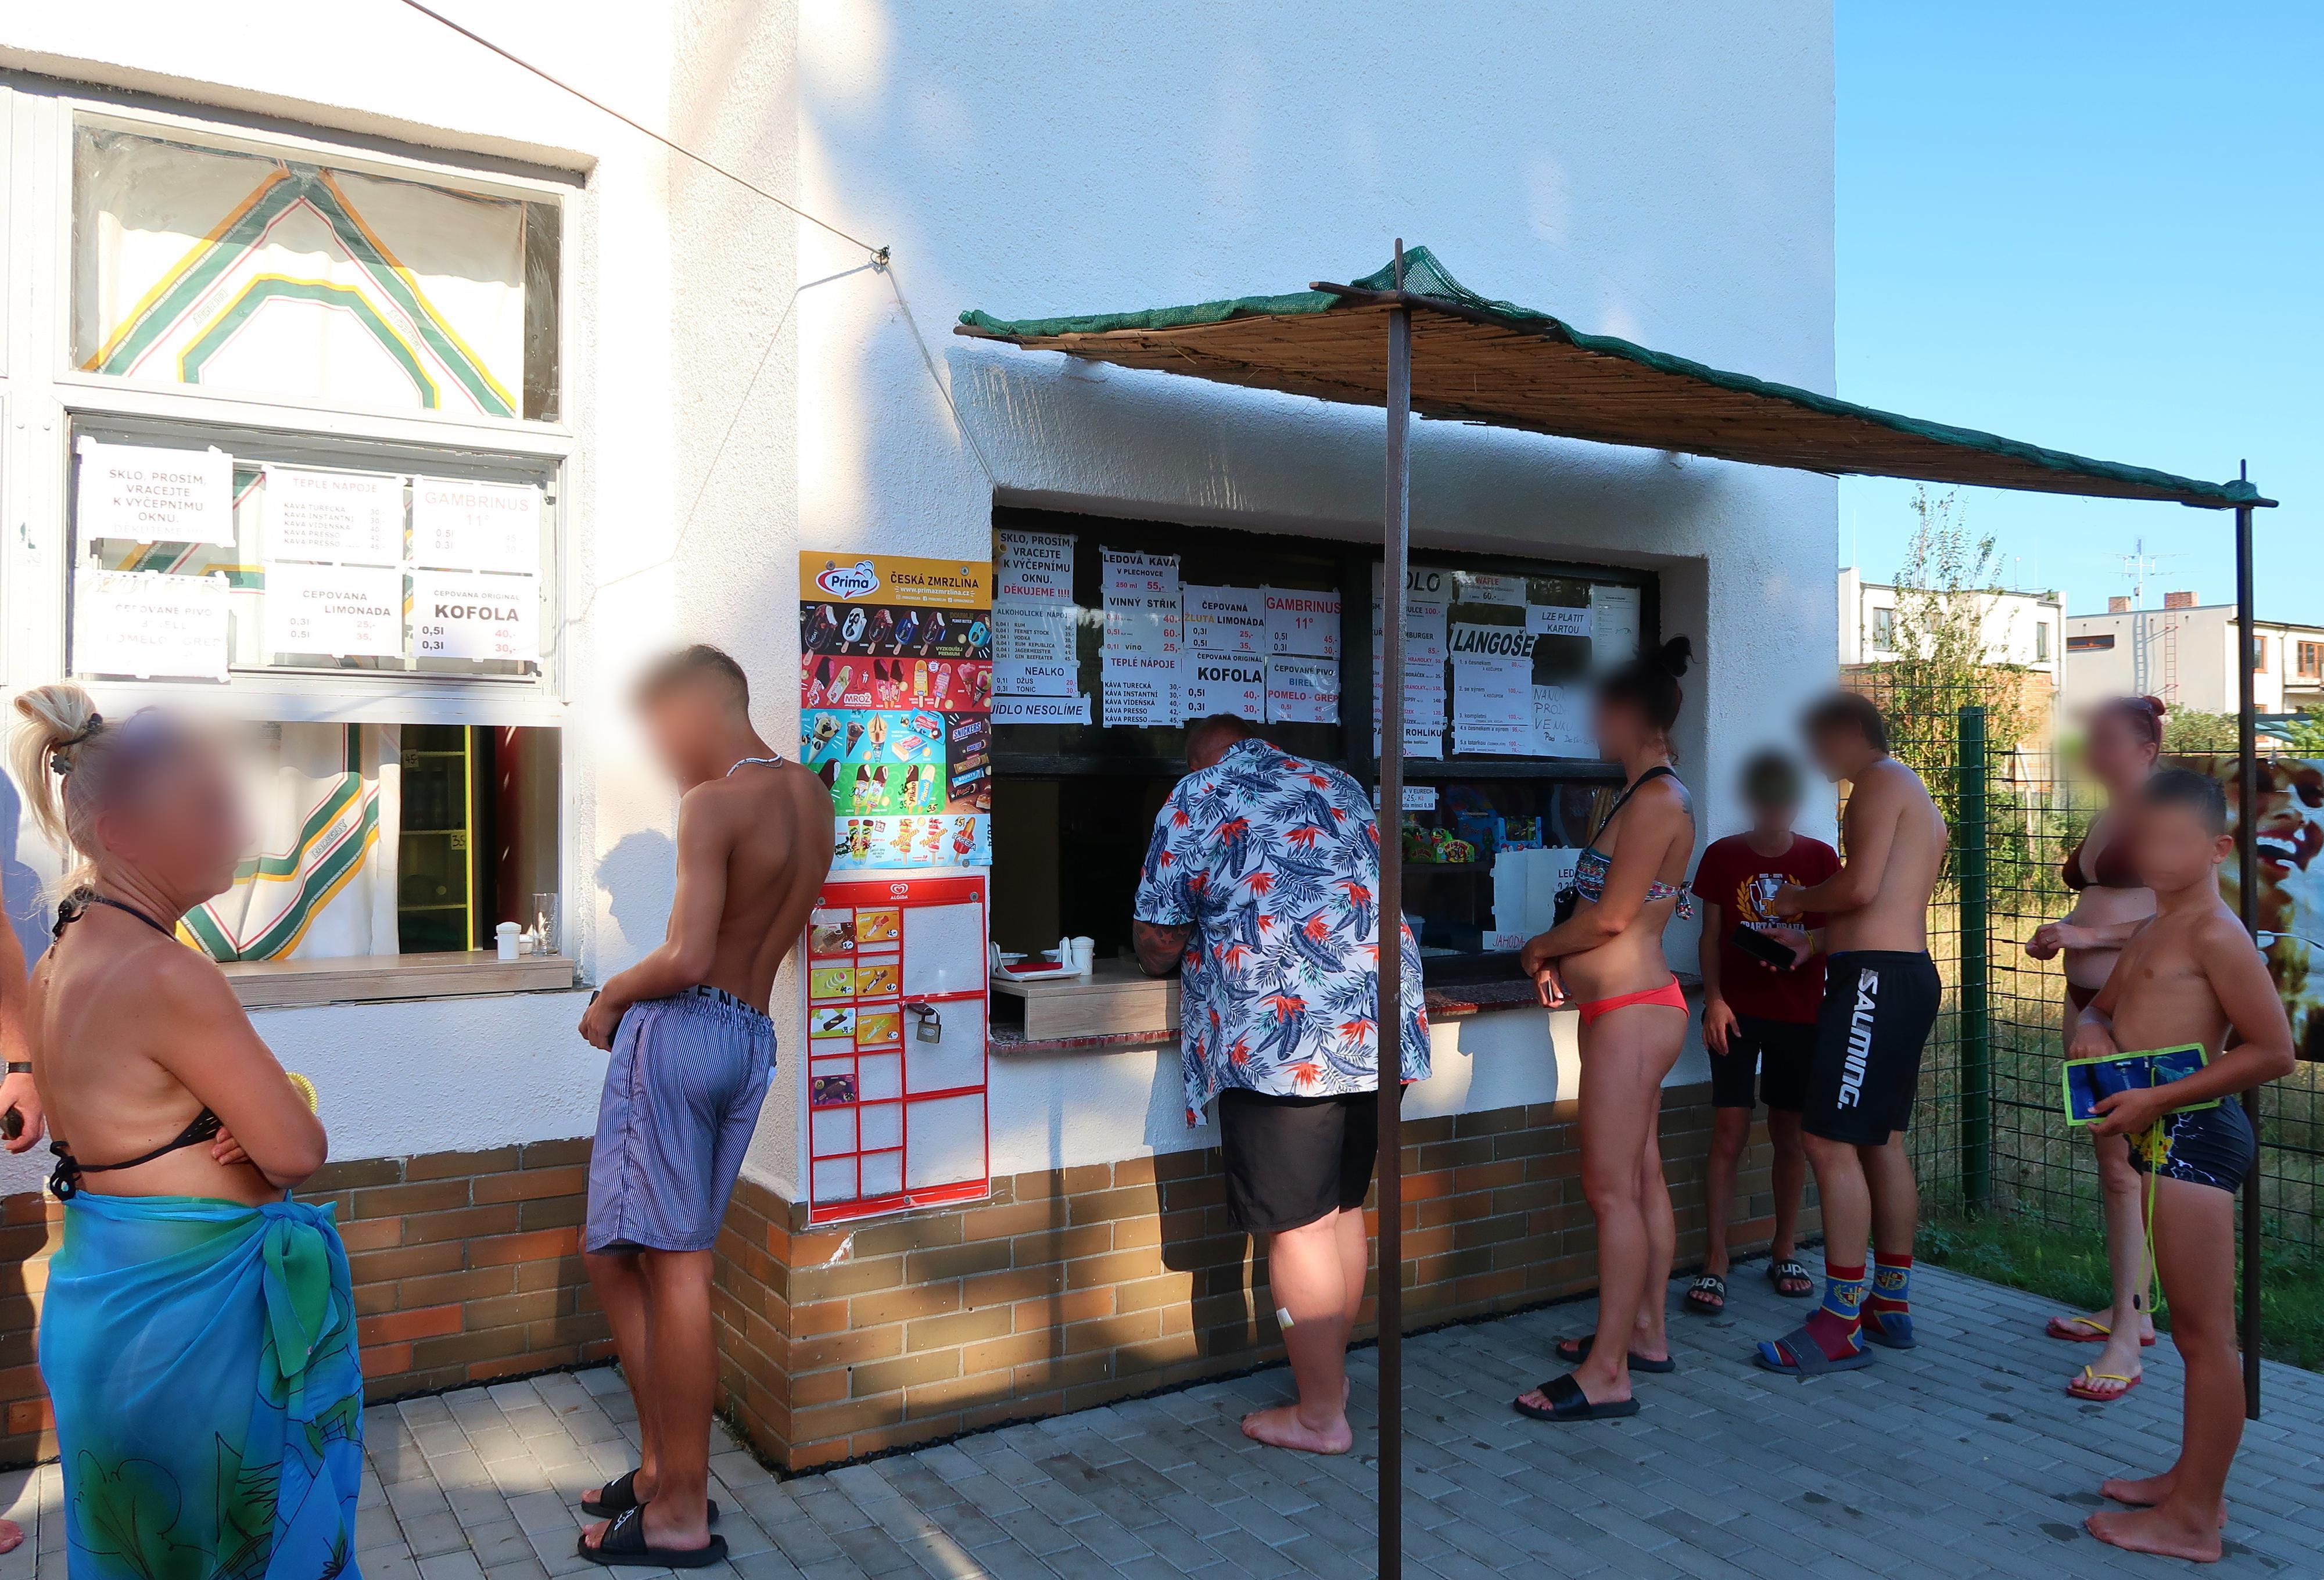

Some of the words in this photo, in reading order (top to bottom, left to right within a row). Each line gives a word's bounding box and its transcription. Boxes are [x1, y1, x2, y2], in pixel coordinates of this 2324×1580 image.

[127, 484, 190, 496] VRACEJTE
[114, 497, 121, 506] K
[425, 492, 528, 511] GAMBRINUS
[1000, 533, 1028, 545] SKLO,
[1032, 536, 1073, 549] PROSÍM,
[1013, 547, 1061, 558] VRACEJTE
[1004, 559, 1010, 568] K
[1013, 558, 1070, 572] VÝČEPNÍMU
[1104, 554, 1143, 565] LEDOVÁ
[1149, 558, 1176, 567] KÁVA
[831, 575, 869, 589] Prima
[891, 572, 924, 585] ČESKÁ
[928, 576, 979, 588] ZMRZLINA
[1022, 574, 1052, 584] OKNU.
[1476, 577, 1500, 586] WAFLE
[901, 587, 970, 596] www.primazmrzlina.cz
[1004, 583, 1055, 597] DĚKUJEME
[1058, 589, 1069, 598] !!!!
[1147, 581, 1164, 591] 55,-
[1109, 597, 1141, 606] VINNÝ
[1147, 598, 1177, 609] STŘIK
[1202, 600, 1247, 612] ČEPOVANÁ
[1267, 597, 1342, 613] GAMBRINUS
[435, 604, 519, 622] KOFOLA
[997, 609, 1043, 617] ALKOHOLICKÉ
[1185, 612, 1214, 623] ŽLUTÁ
[1218, 616, 1264, 626] LIMONÁDA
[1542, 612, 1556, 620] LZE
[1558, 613, 1584, 623] PLATIT
[422, 626, 444, 636] 0,5l
[1193, 627, 1207, 635] 0,3l
[1547, 624, 1579, 634] KARTOU
[1275, 632, 1287, 641] 0,5l
[1324, 635, 1337, 645] 45,-
[1454, 629, 1535, 657] LANGOŠE
[422, 641, 444, 651] 0,3l
[1163, 644, 1181, 653] 25,-
[1274, 644, 1287, 652] 0,3l
[1324, 647, 1337, 655] 30,-
[1111, 656, 1138, 667] TEPLÉ
[1141, 657, 1175, 668] NÁPOJE
[1197, 652, 1231, 660] ČEPOVANÁ
[1025, 667, 1064, 676] NEALKO
[1198, 667, 1263, 683] KOFOLA
[1275, 665, 1314, 674] ČEPOVANÉ
[845, 694, 871, 703] MROŽ
[1188, 688, 1204, 698] 0,5l
[1244, 691, 1260, 701] 40,-
[1268, 690, 1306, 700] POMELO
[1315, 694, 1339, 702] GREP
[991, 702, 1023, 714] JÍDLO
[1025, 703, 1083, 715] NESOLÍME
[1188, 702, 1204, 712] 0,3l
[1244, 705, 1260, 714] 30,-
[954, 722, 981, 739] SNICKERS
[1406, 728, 1441, 737] ROHLÍKU
[959, 772, 975, 782] BOUNTY
[952, 832, 976, 851] RAKETA
[1558, 869, 1575, 878] LED
